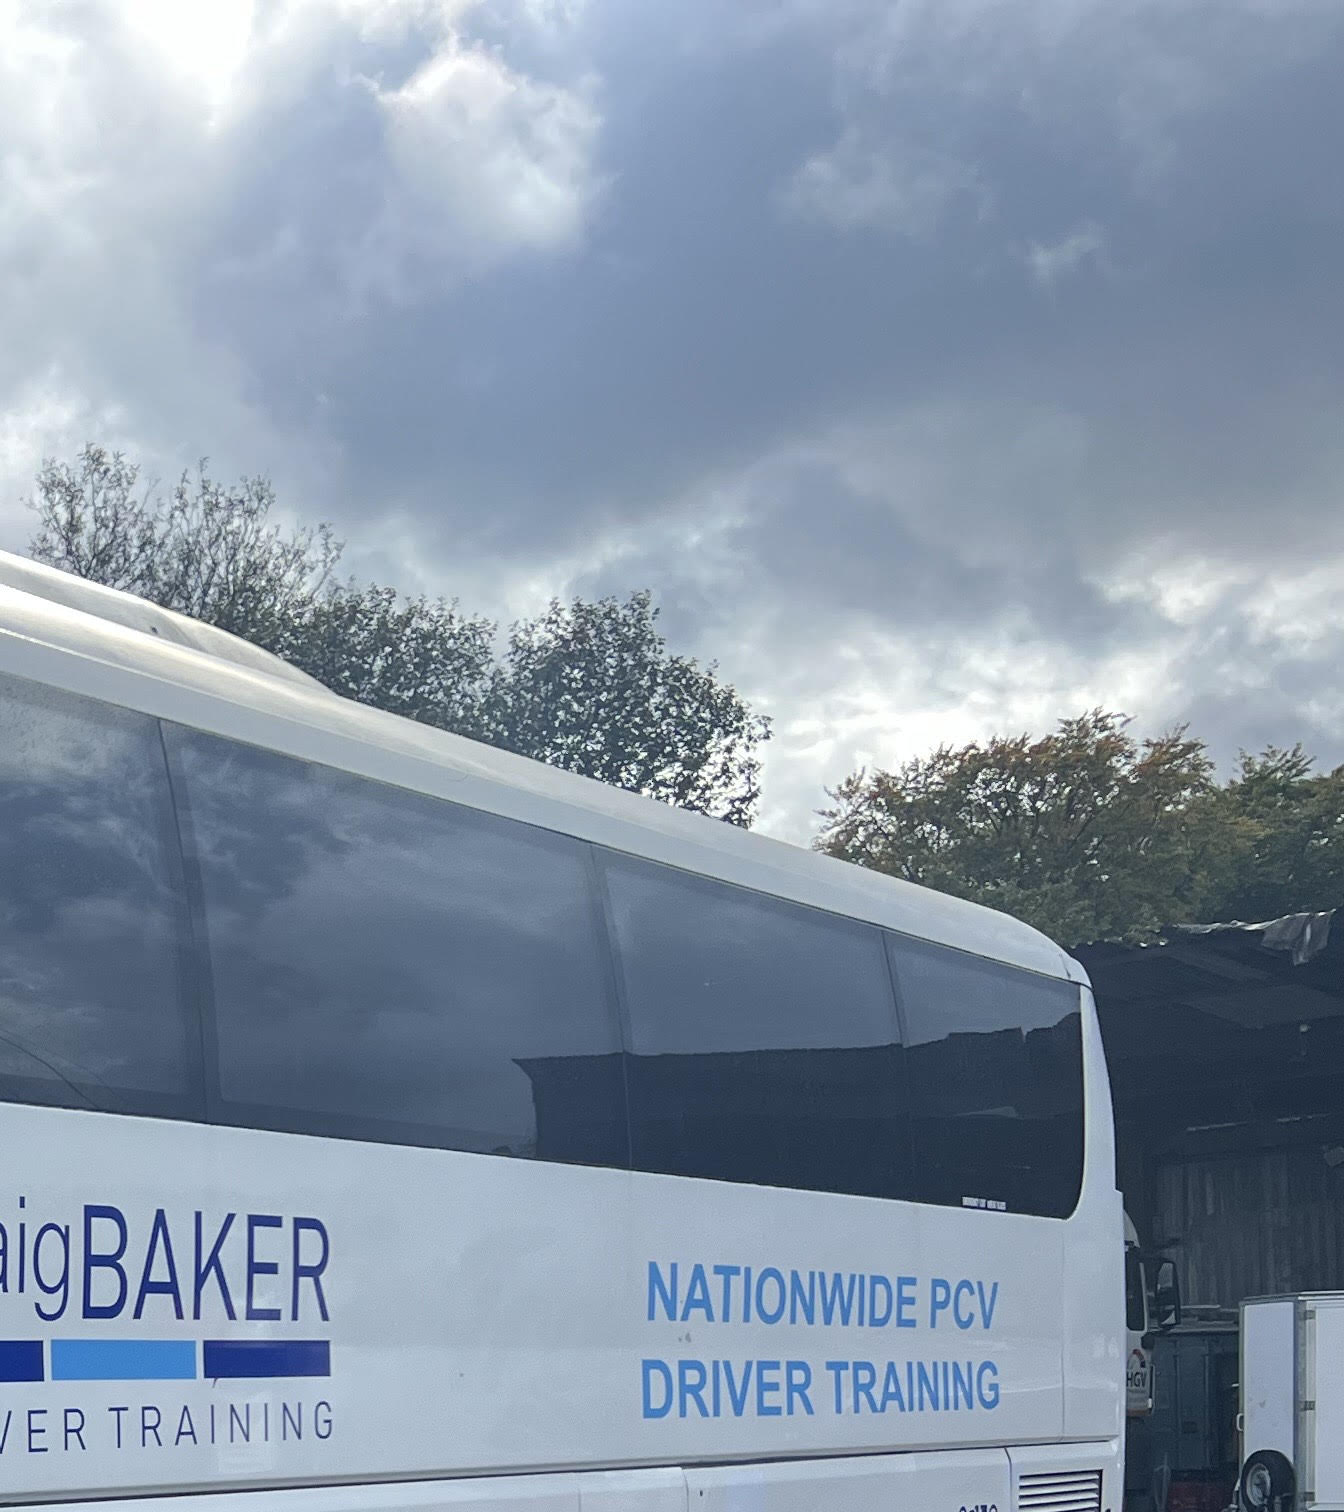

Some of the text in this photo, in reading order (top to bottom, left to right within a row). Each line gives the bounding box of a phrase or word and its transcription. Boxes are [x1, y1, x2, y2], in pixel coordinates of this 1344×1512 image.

[648, 1262, 999, 1330] NATIONWIDE PCV
[642, 1359, 1000, 1419] DRIVER TRAINING
[108, 1400, 335, 1449] TRAINING
